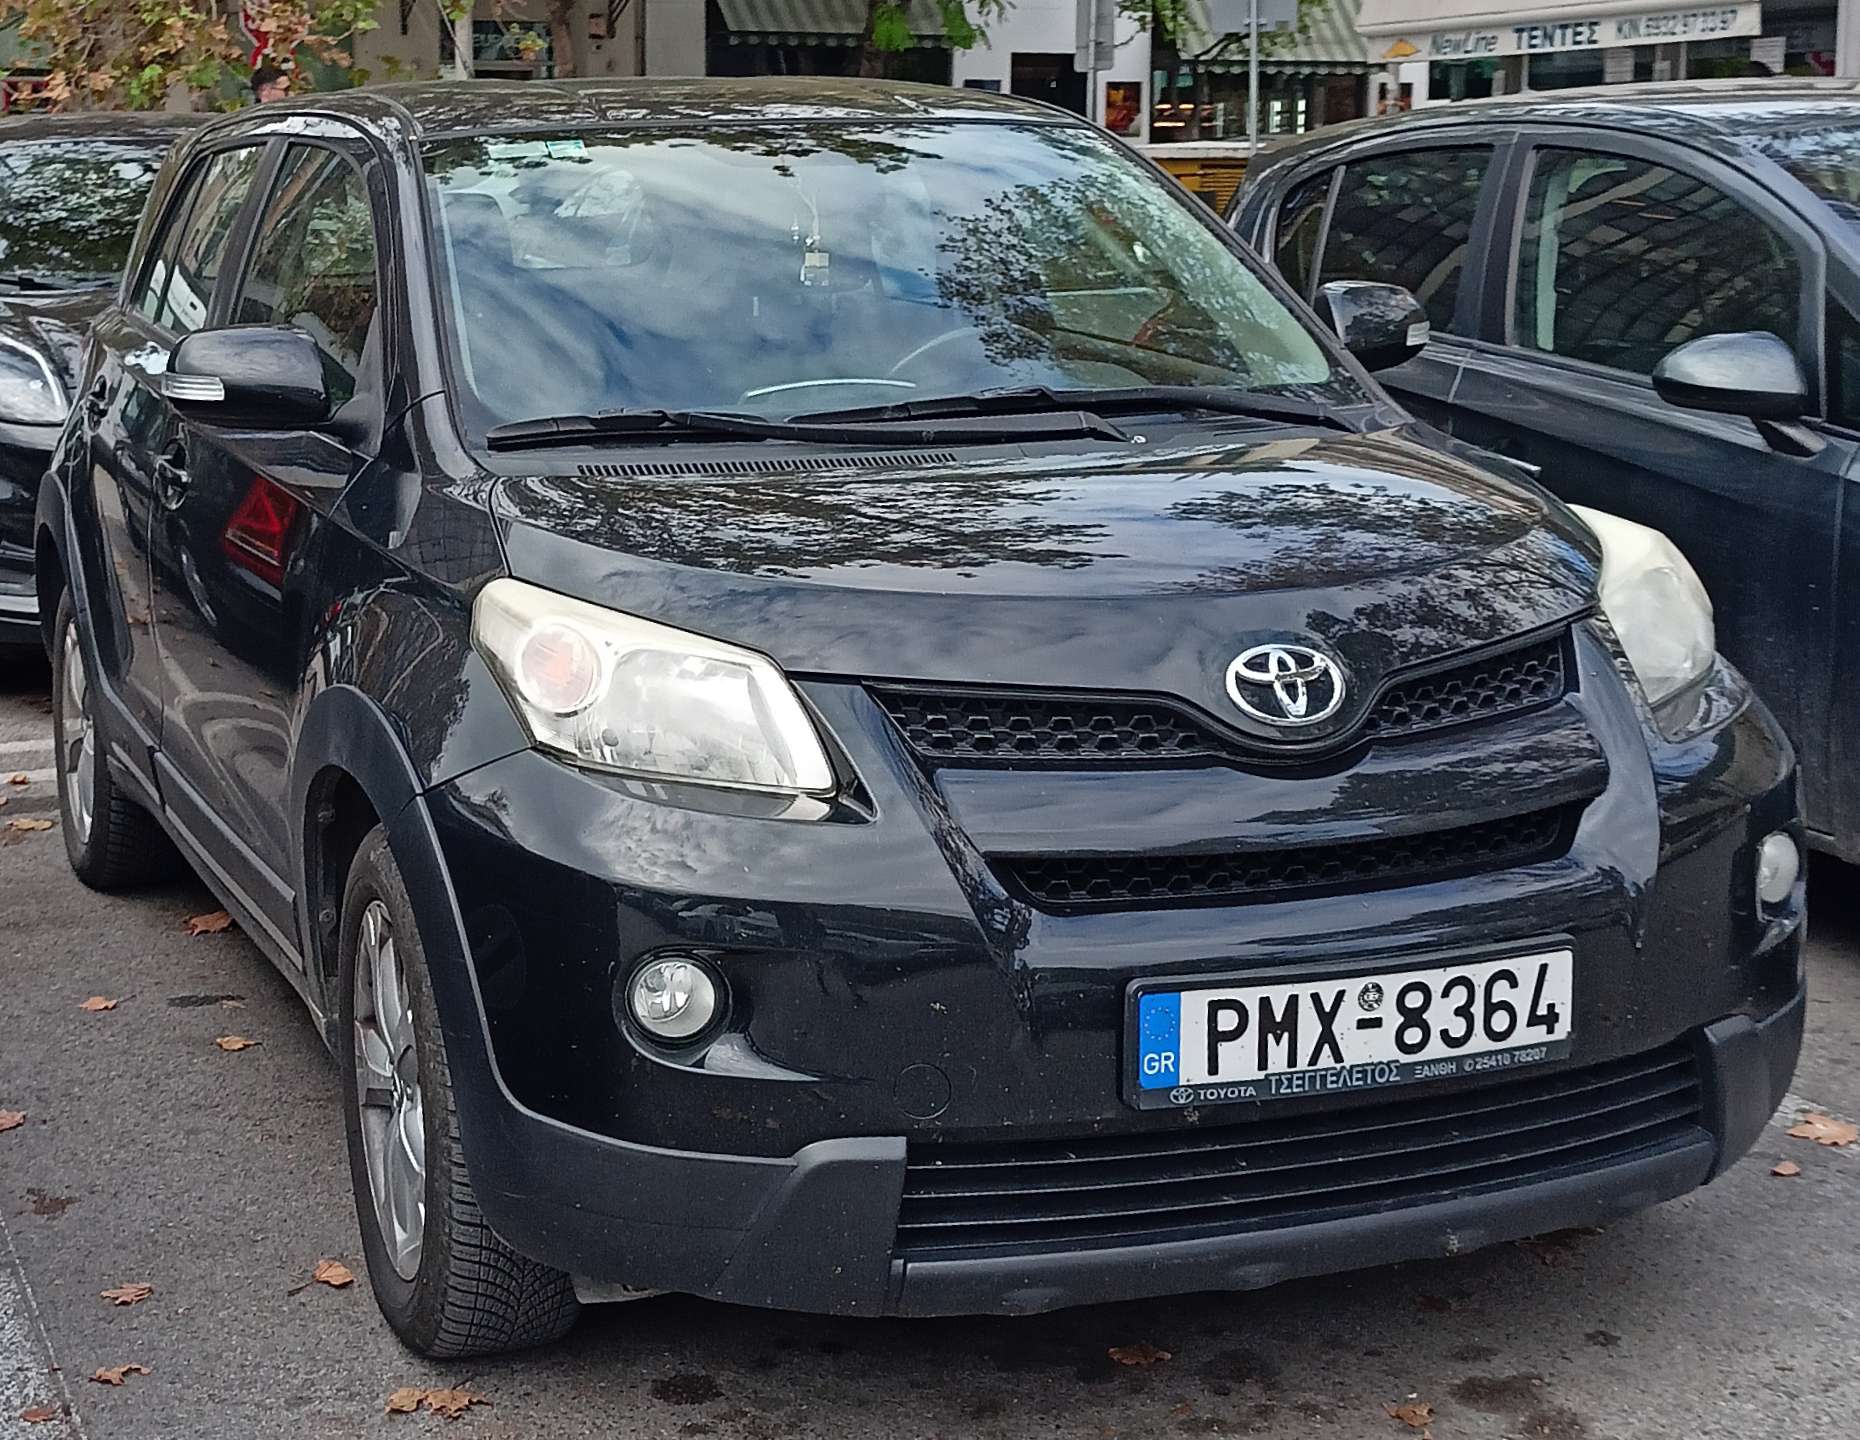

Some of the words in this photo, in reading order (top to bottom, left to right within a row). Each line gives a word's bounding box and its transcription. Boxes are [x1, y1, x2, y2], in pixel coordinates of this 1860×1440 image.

[1513, 21, 1601, 50] ΤΕΝΤΕΣ
[1143, 1052, 1175, 1075] GR
[1198, 1086, 1257, 1101] TOYOTA
[1269, 1062, 1401, 1095] ΤΣΕΓΓΕΛΕΤΟΣ
[1414, 1062, 1457, 1078] ΞΑΝΘΗ
